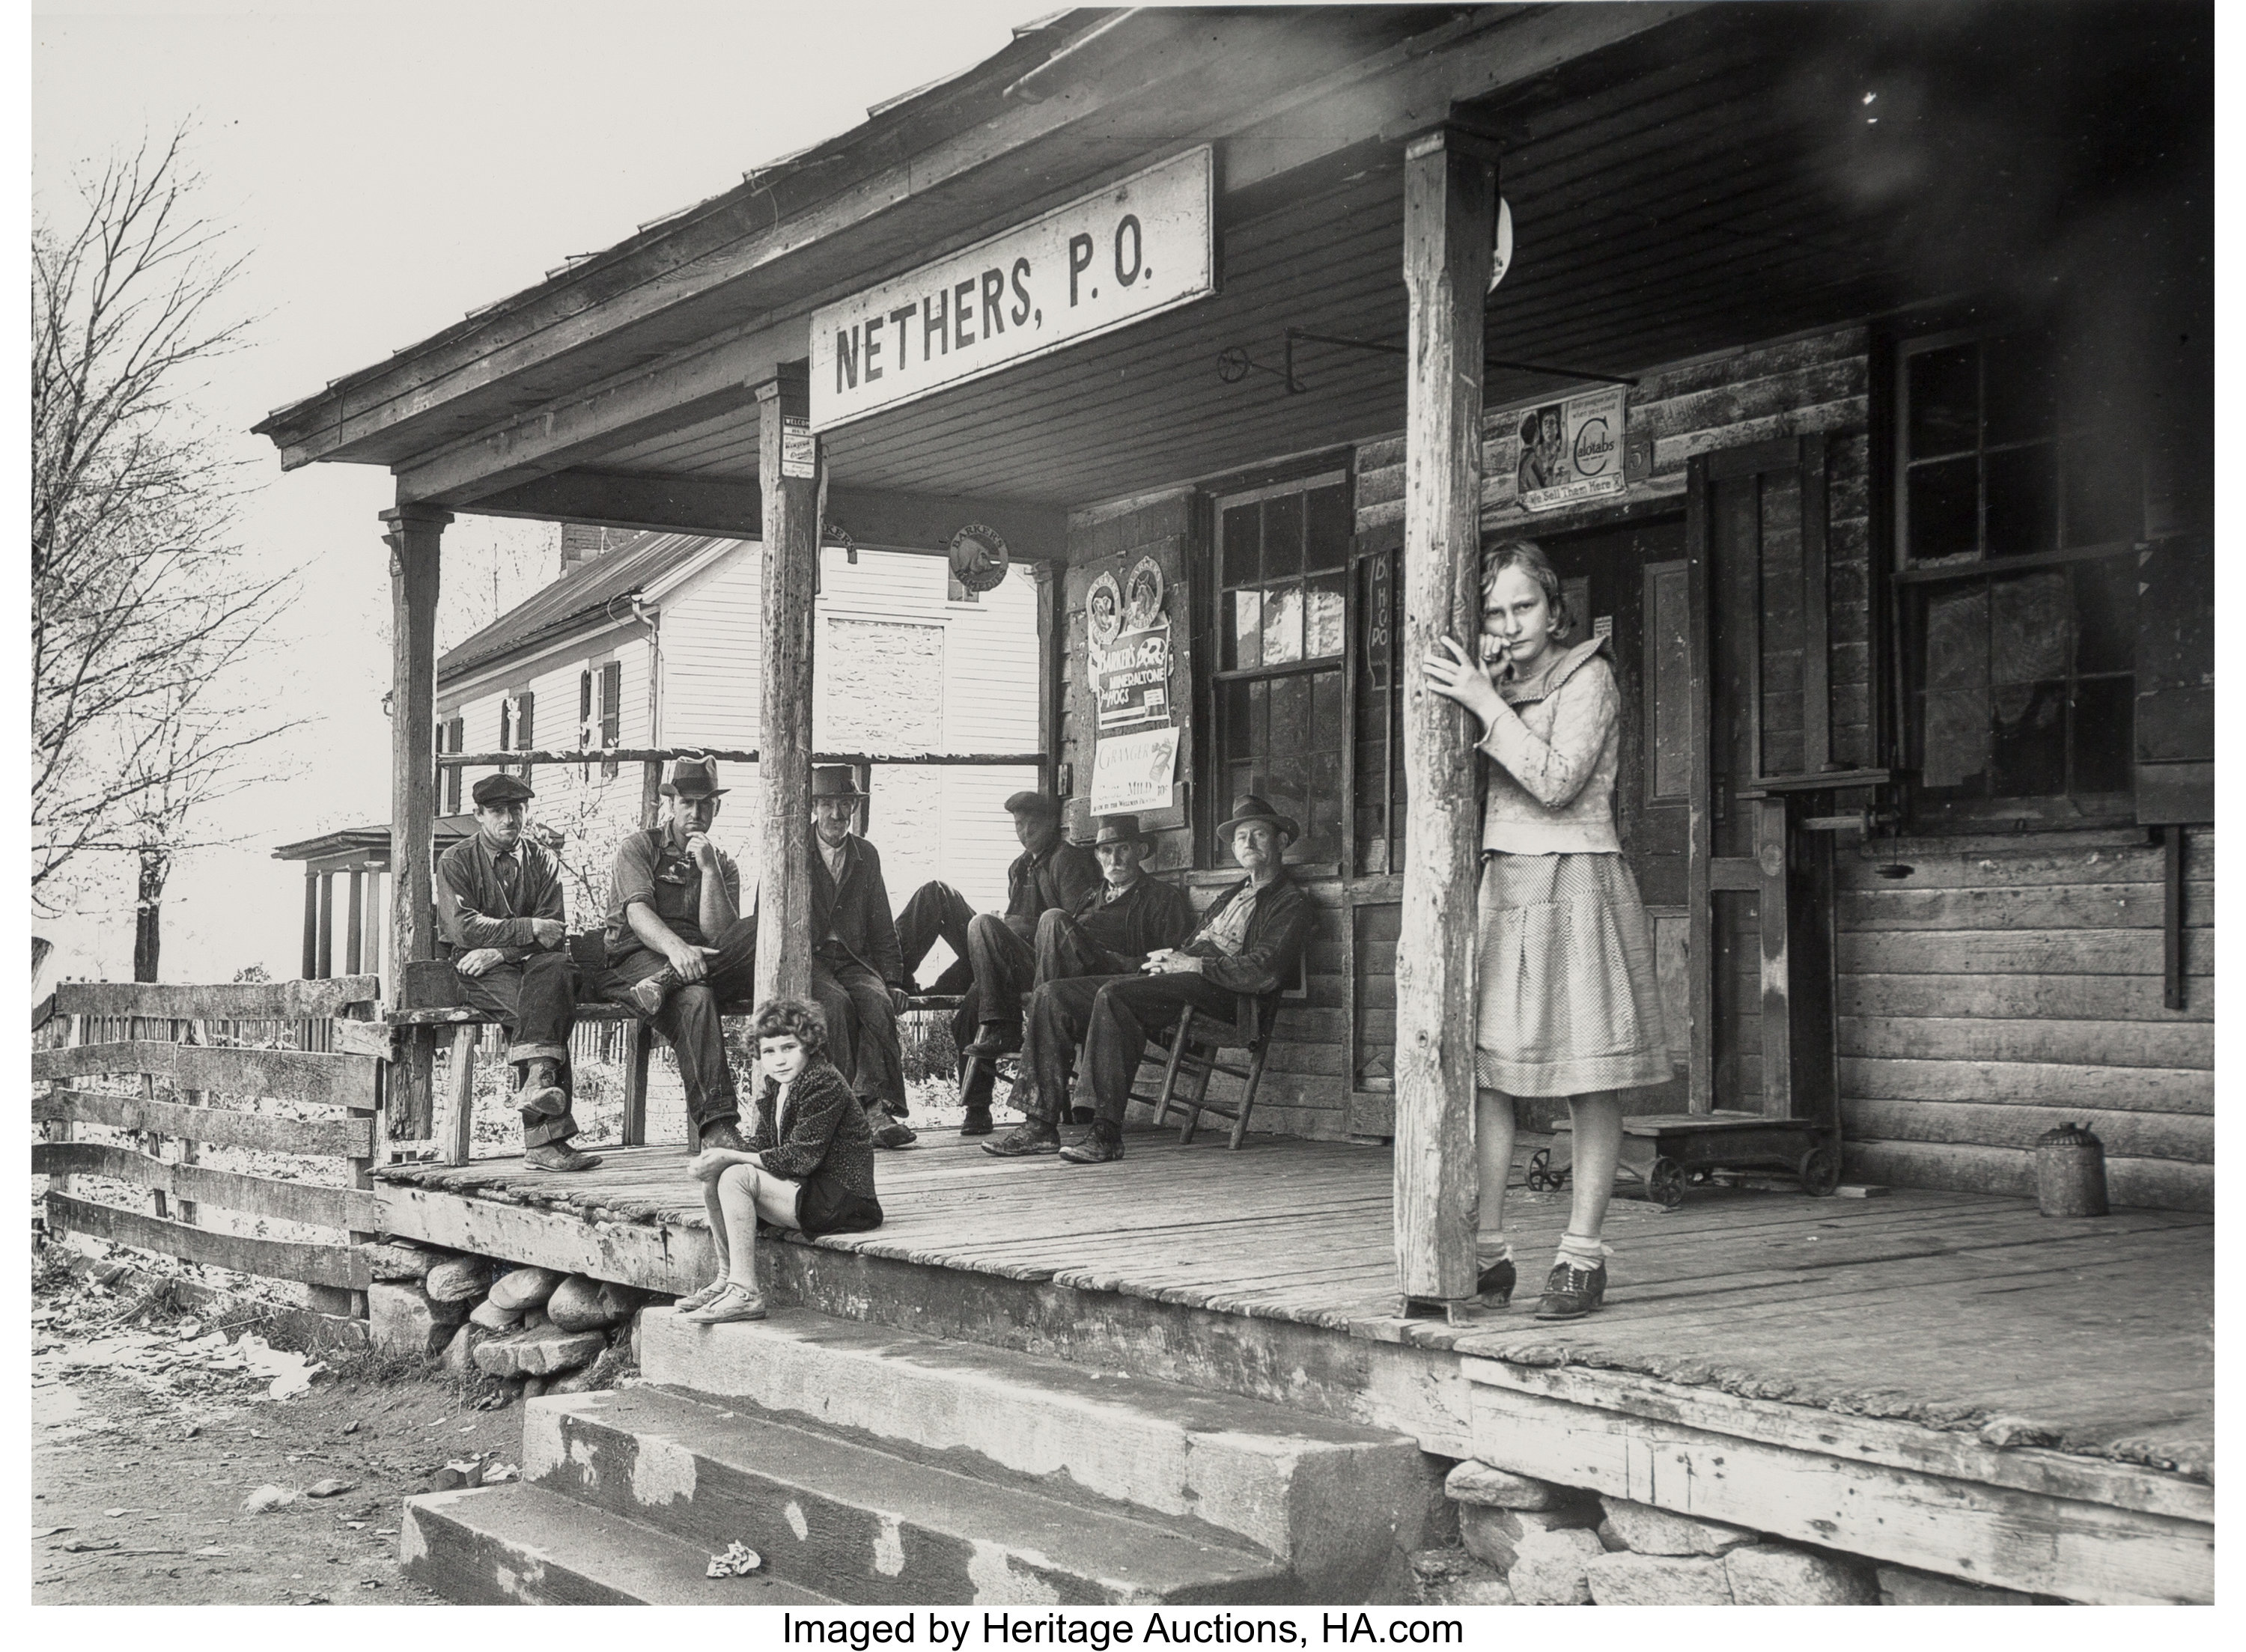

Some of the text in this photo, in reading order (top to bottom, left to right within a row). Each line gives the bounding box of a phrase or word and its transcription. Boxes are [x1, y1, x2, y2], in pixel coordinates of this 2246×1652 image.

[836, 214, 1152, 395] NETHERS, P. O.
[785, 418, 810, 427] WELCOM
[1574, 415, 1615, 476] Calotabs
[1544, 490, 1560, 501] Sell
[1589, 480, 1611, 493] Here
[824, 523, 854, 554] KER'S
[952, 525, 1003, 549] BARKER'S
[1100, 644, 1136, 674] BARKER'S
[1110, 667, 1165, 690] MINERALTONE
[1107, 687, 1129, 707] HOGS
